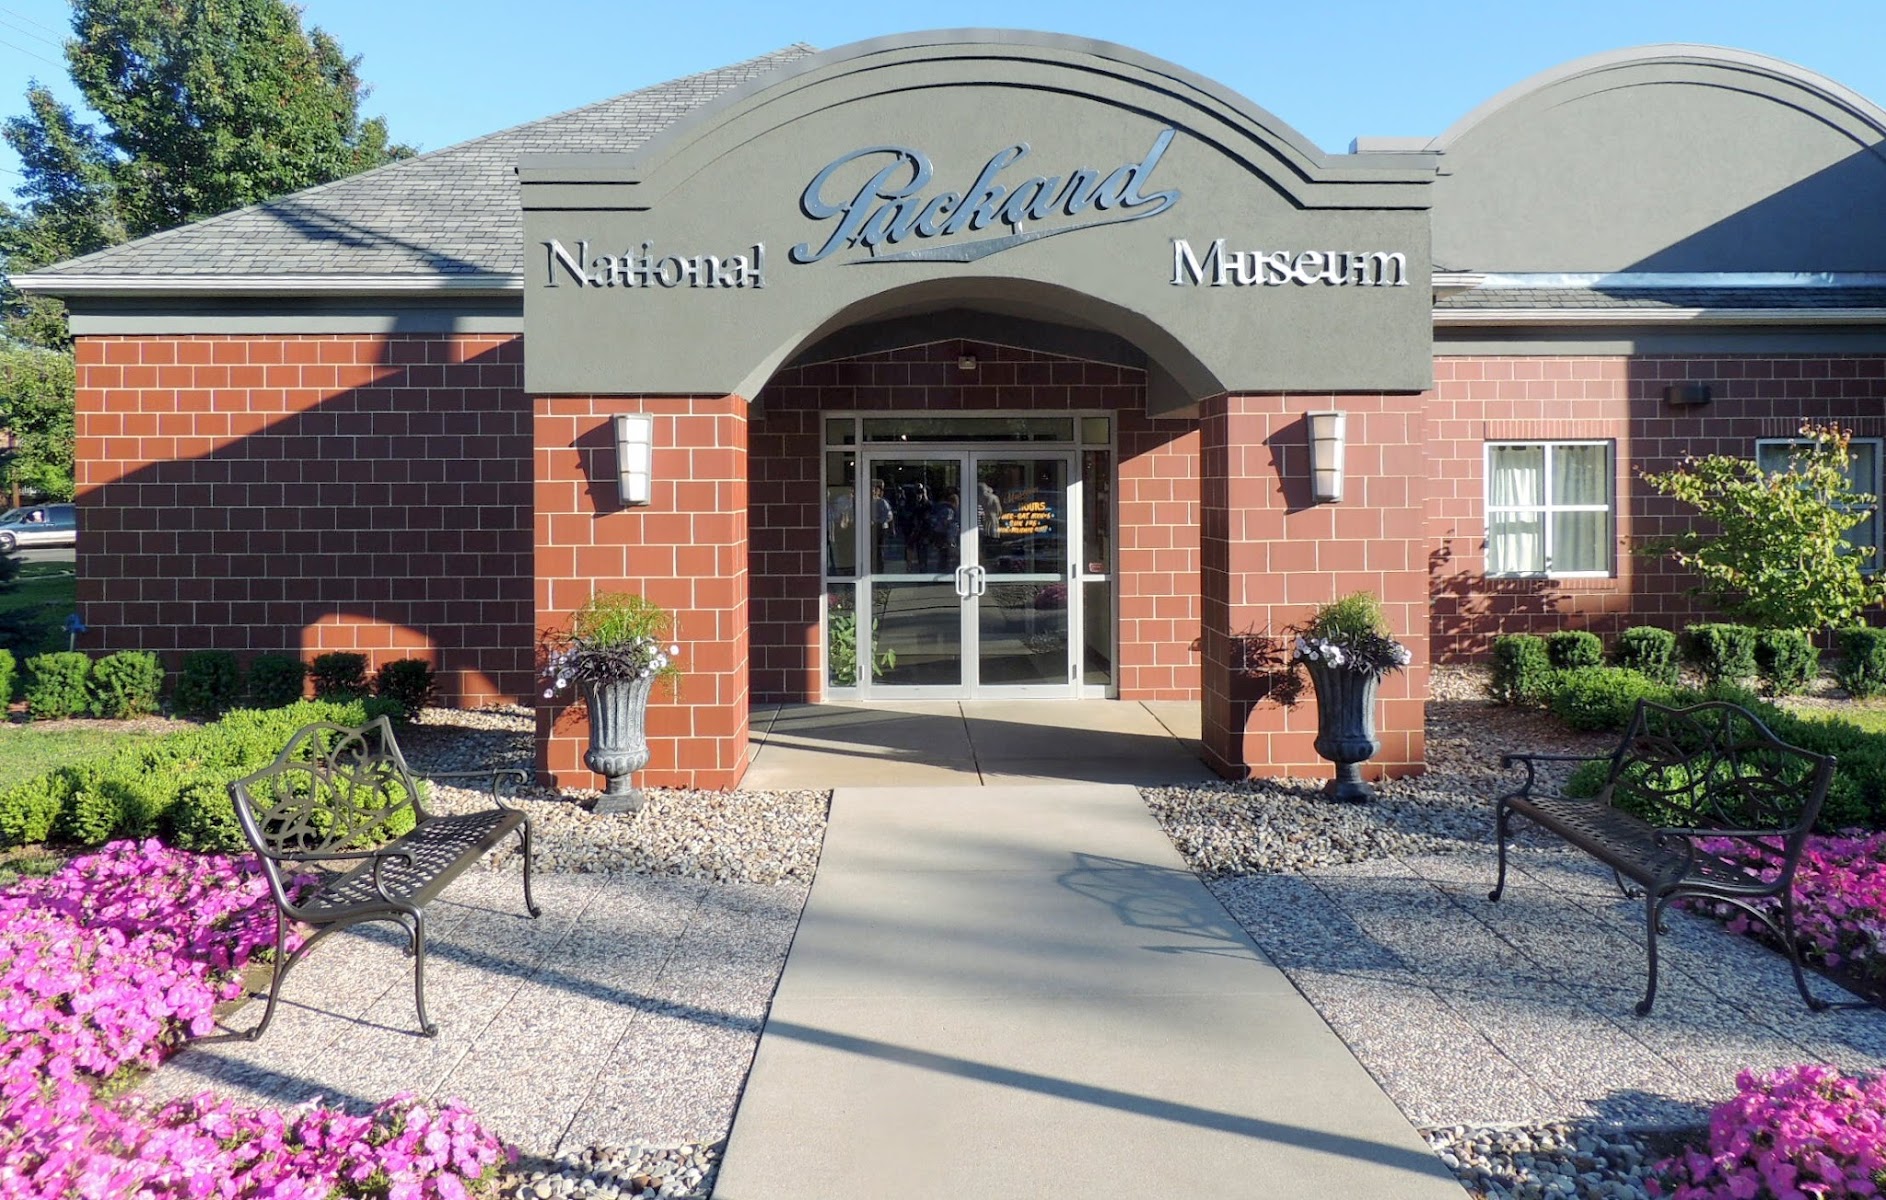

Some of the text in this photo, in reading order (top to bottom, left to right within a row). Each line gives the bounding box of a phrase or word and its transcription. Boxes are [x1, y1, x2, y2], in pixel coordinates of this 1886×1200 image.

[541, 128, 1410, 288] National Packard Museum
